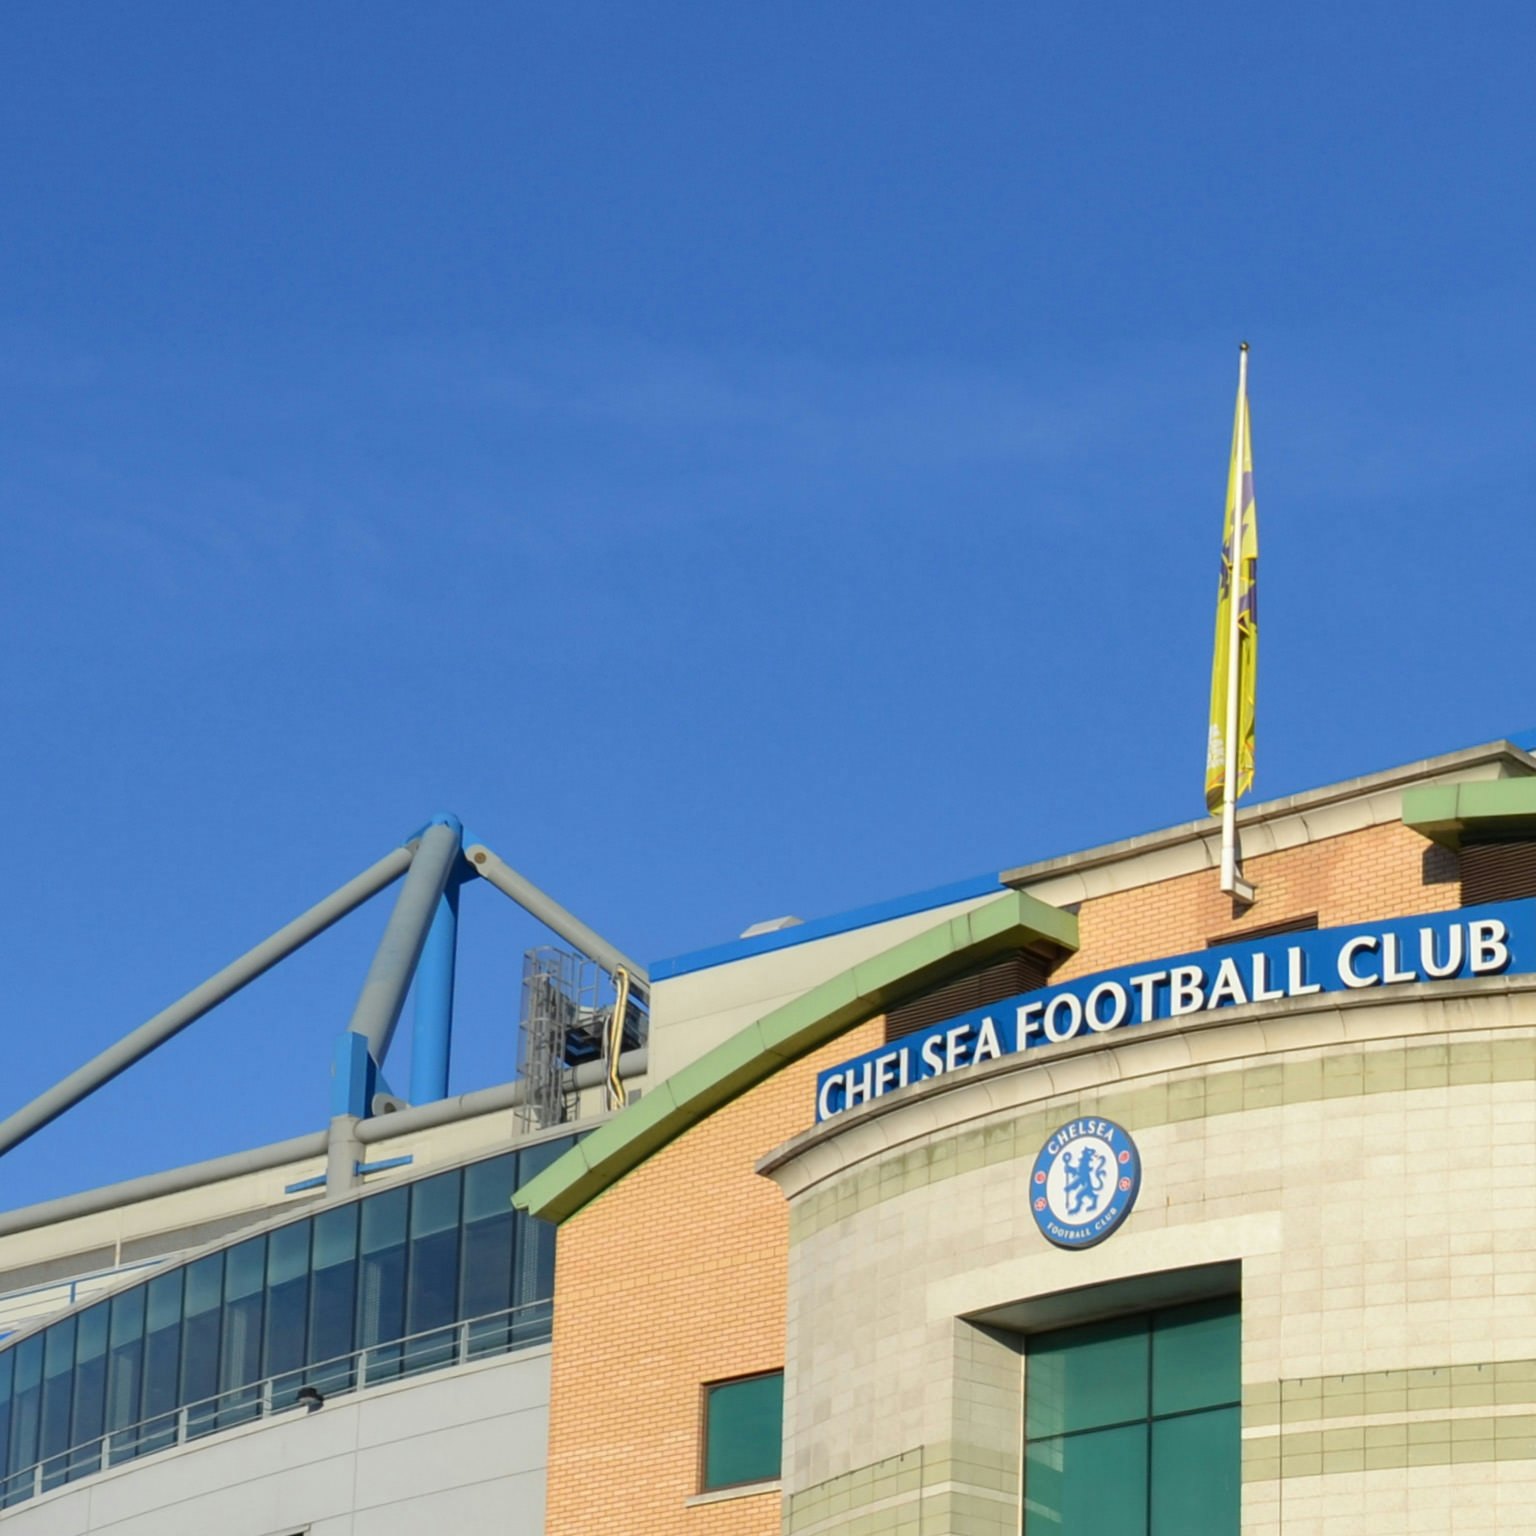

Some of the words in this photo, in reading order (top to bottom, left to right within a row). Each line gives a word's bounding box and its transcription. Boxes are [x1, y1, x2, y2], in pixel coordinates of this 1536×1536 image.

[818, 1016, 1002, 1121] CHELSEA
[1016, 947, 1321, 1051] FOOTBALL
[1337, 919, 1509, 988] CLUB
[1047, 1120, 1115, 1155] CHELSEA
[1047, 1221, 1092, 1240] FOOTBALL
[1095, 1207, 1118, 1230] CLUB
